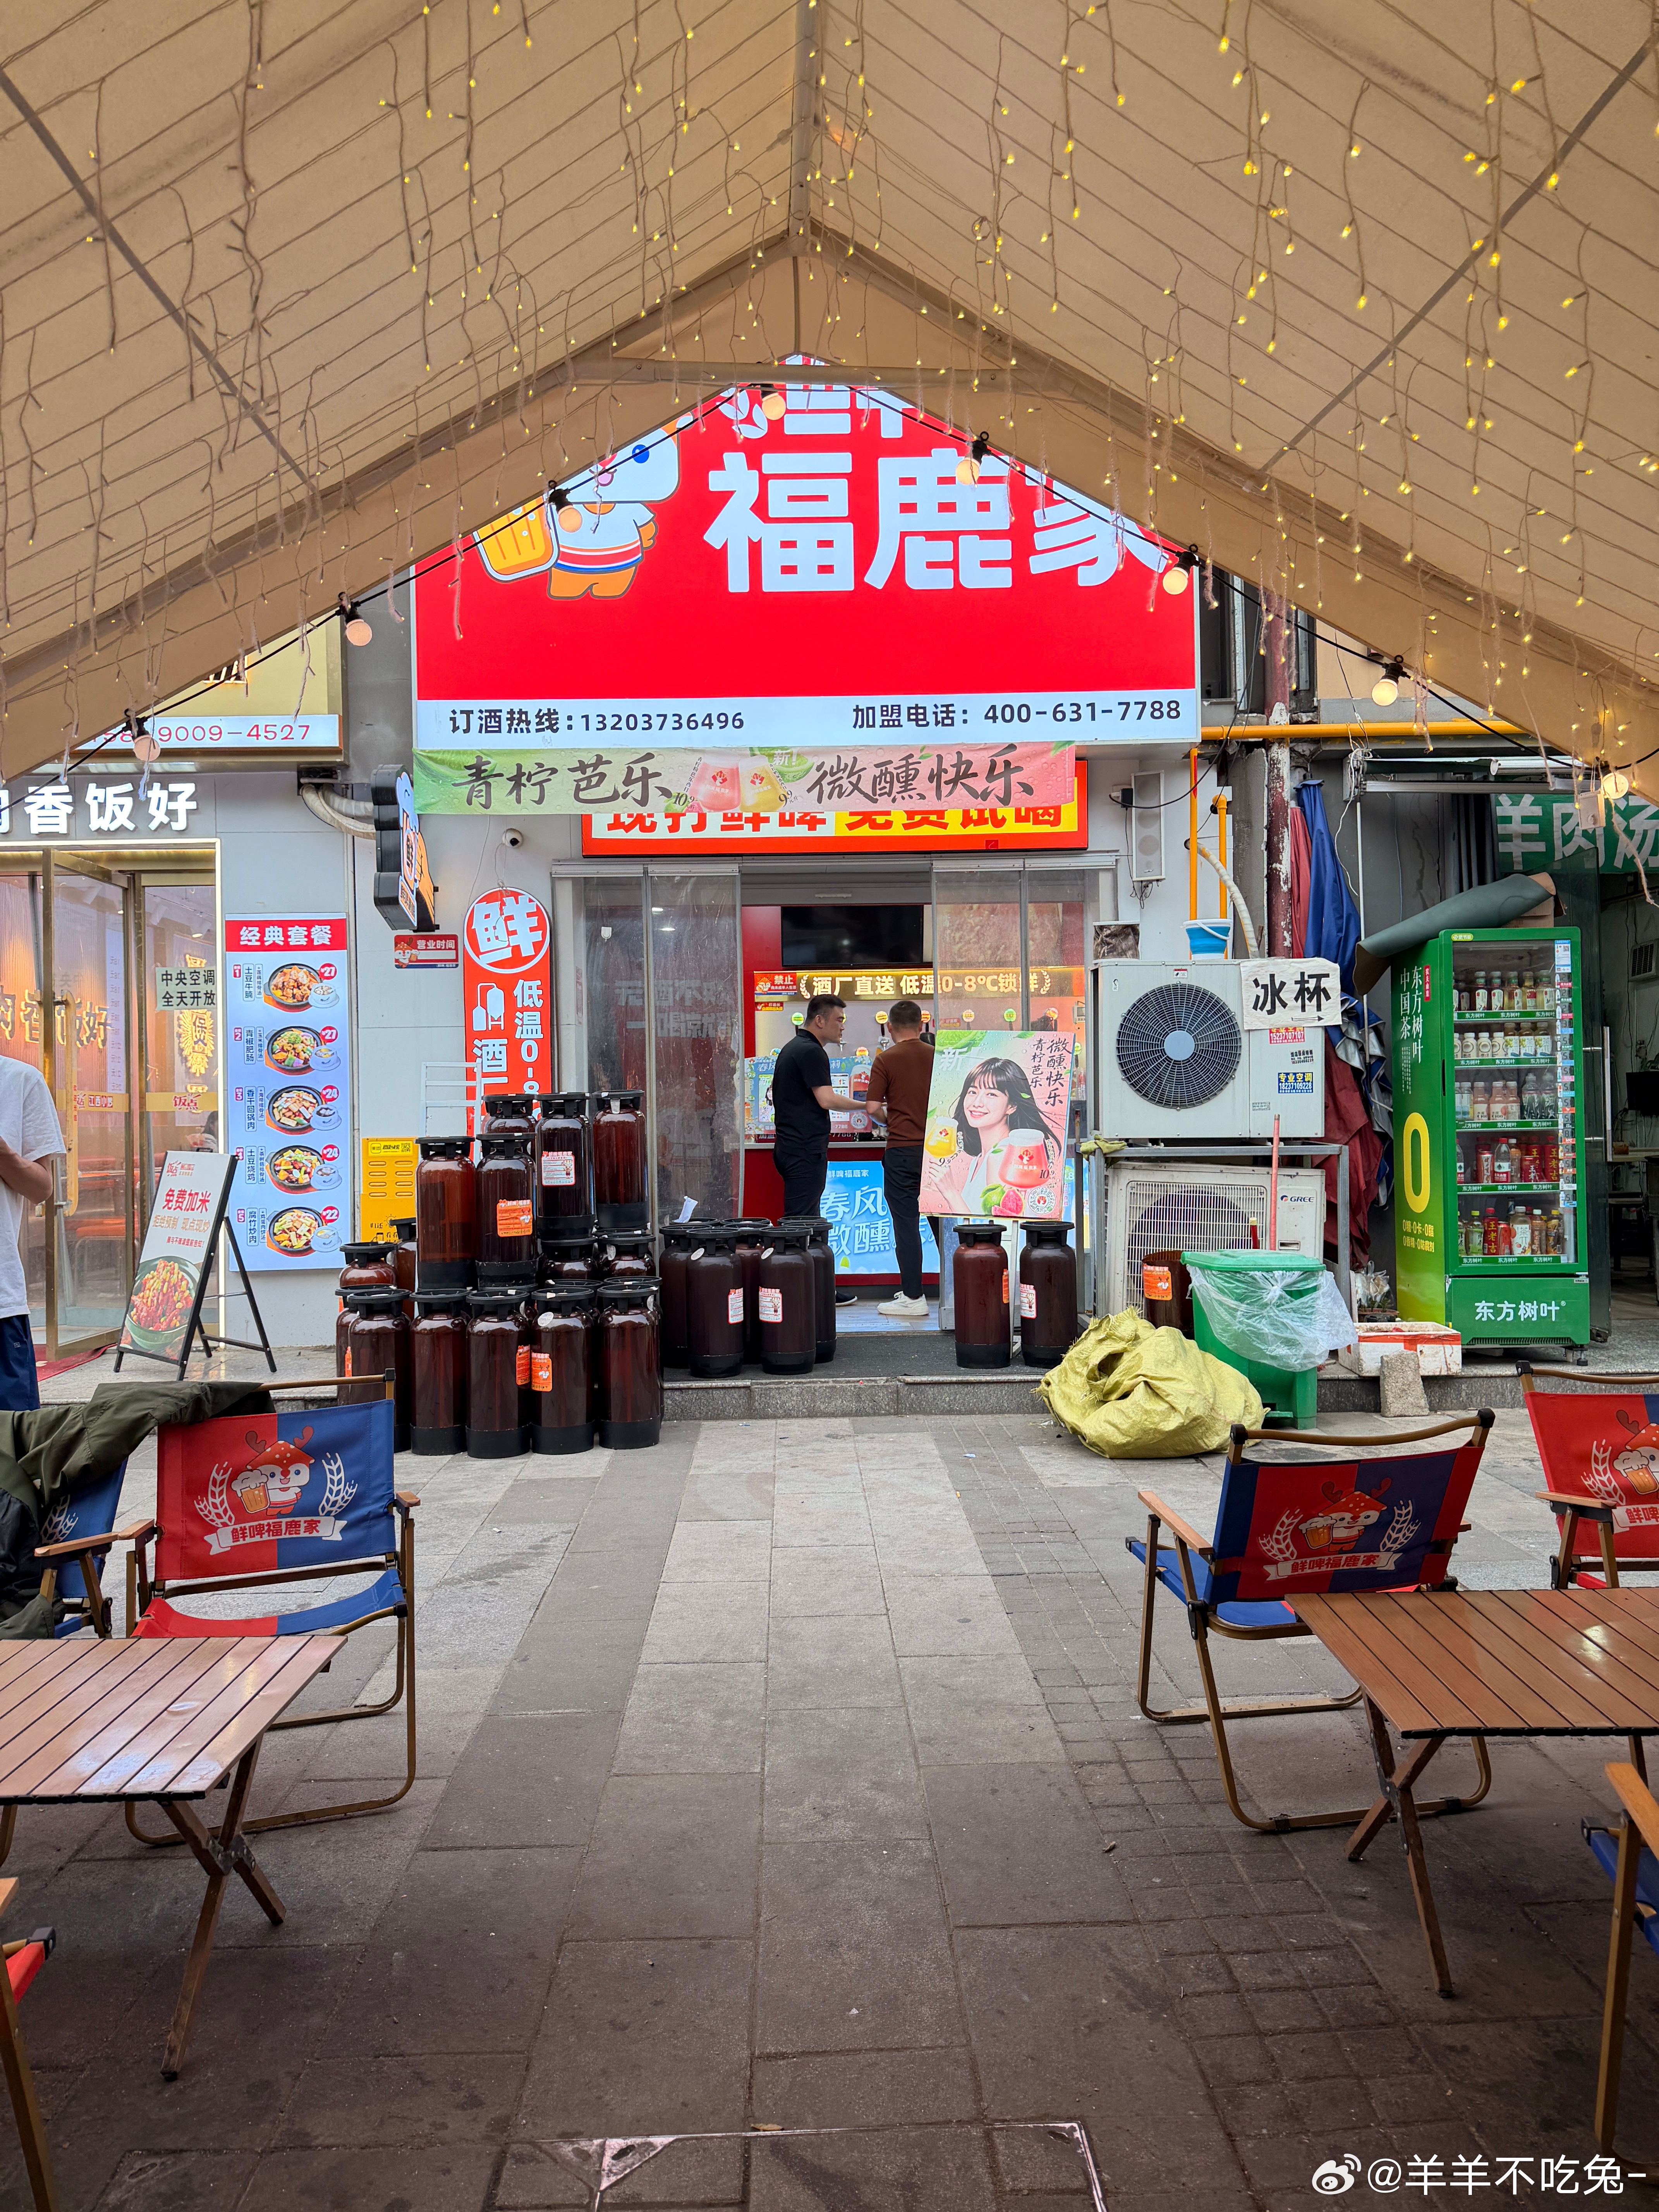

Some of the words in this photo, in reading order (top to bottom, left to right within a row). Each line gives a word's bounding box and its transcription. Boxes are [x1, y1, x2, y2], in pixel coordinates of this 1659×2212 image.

[984, 700, 1181, 724] 400-631-7788
[452, 752, 673, 809] 青柠芭乐
[807, 744, 1035, 806] 微醺快乐
[0, 783, 197, 834] 香饭好
[1496, 794, 1659, 870] 羊肉汤
[240, 925, 332, 946] 经典套餐
[417, 940, 455, 949] 营业时间
[472, 895, 543, 965] 鲜
[161, 969, 215, 986] 中央空调
[775, 975, 793, 984] 禁止
[813, 975, 895, 996] 酒厂直送
[1252, 971, 1332, 1015] 冰杯
[162, 990, 216, 1006] 全天开放
[1400, 968, 1411, 1040] 中国茶
[1411, 966, 1424, 1063] 东方树叶
[246, 1030, 254, 1061] 青椒肥肠
[1270, 1032, 1304, 1040] 15237107107
[1030, 1038, 1046, 1088] 青柠芭乐
[1044, 1037, 1073, 1107] 微醺快乐
[1279, 1073, 1312, 1082] 专业空调
[247, 1090, 255, 1130] 香干回锅肉
[1403, 1113, 1431, 1213] 0
[1549, 1148, 1558, 1181] 王老吉
[162, 1188, 211, 1214] 免费加米
[1488, 1221, 1497, 1253] 王老吉
[1475, 1300, 1559, 1322] 东方树叶
[231, 1519, 321, 1543] 鲜啤福鹿家
[1291, 1554, 1380, 1573] 鲜啤福鹿家
